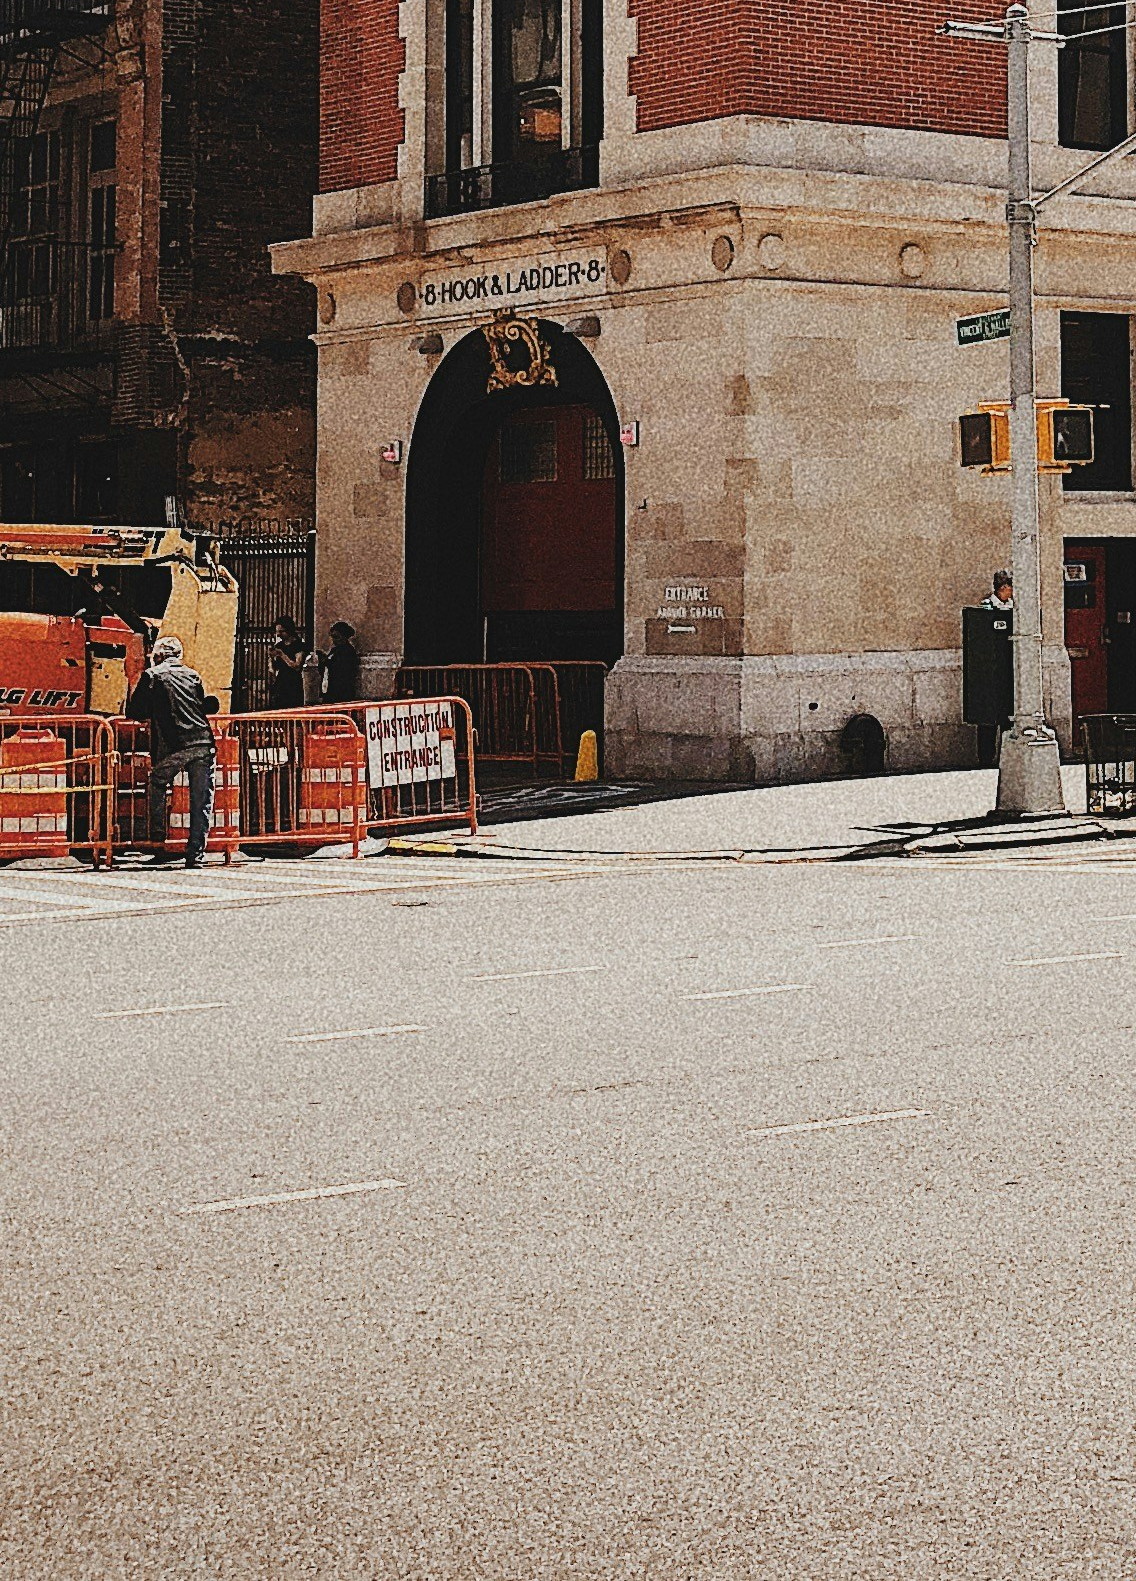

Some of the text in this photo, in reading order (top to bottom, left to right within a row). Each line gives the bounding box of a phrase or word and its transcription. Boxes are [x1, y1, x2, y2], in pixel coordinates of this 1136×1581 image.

[441, 275, 488, 303] HOOK
[490, 275, 503, 296] &
[506, 263, 581, 294] LADDER
[665, 586, 709, 601] ENTRANCE
[28, 690, 82, 707] LIFT
[368, 710, 450, 742] CONSTRUCTION
[383, 746, 440, 773] ENTRANCE
